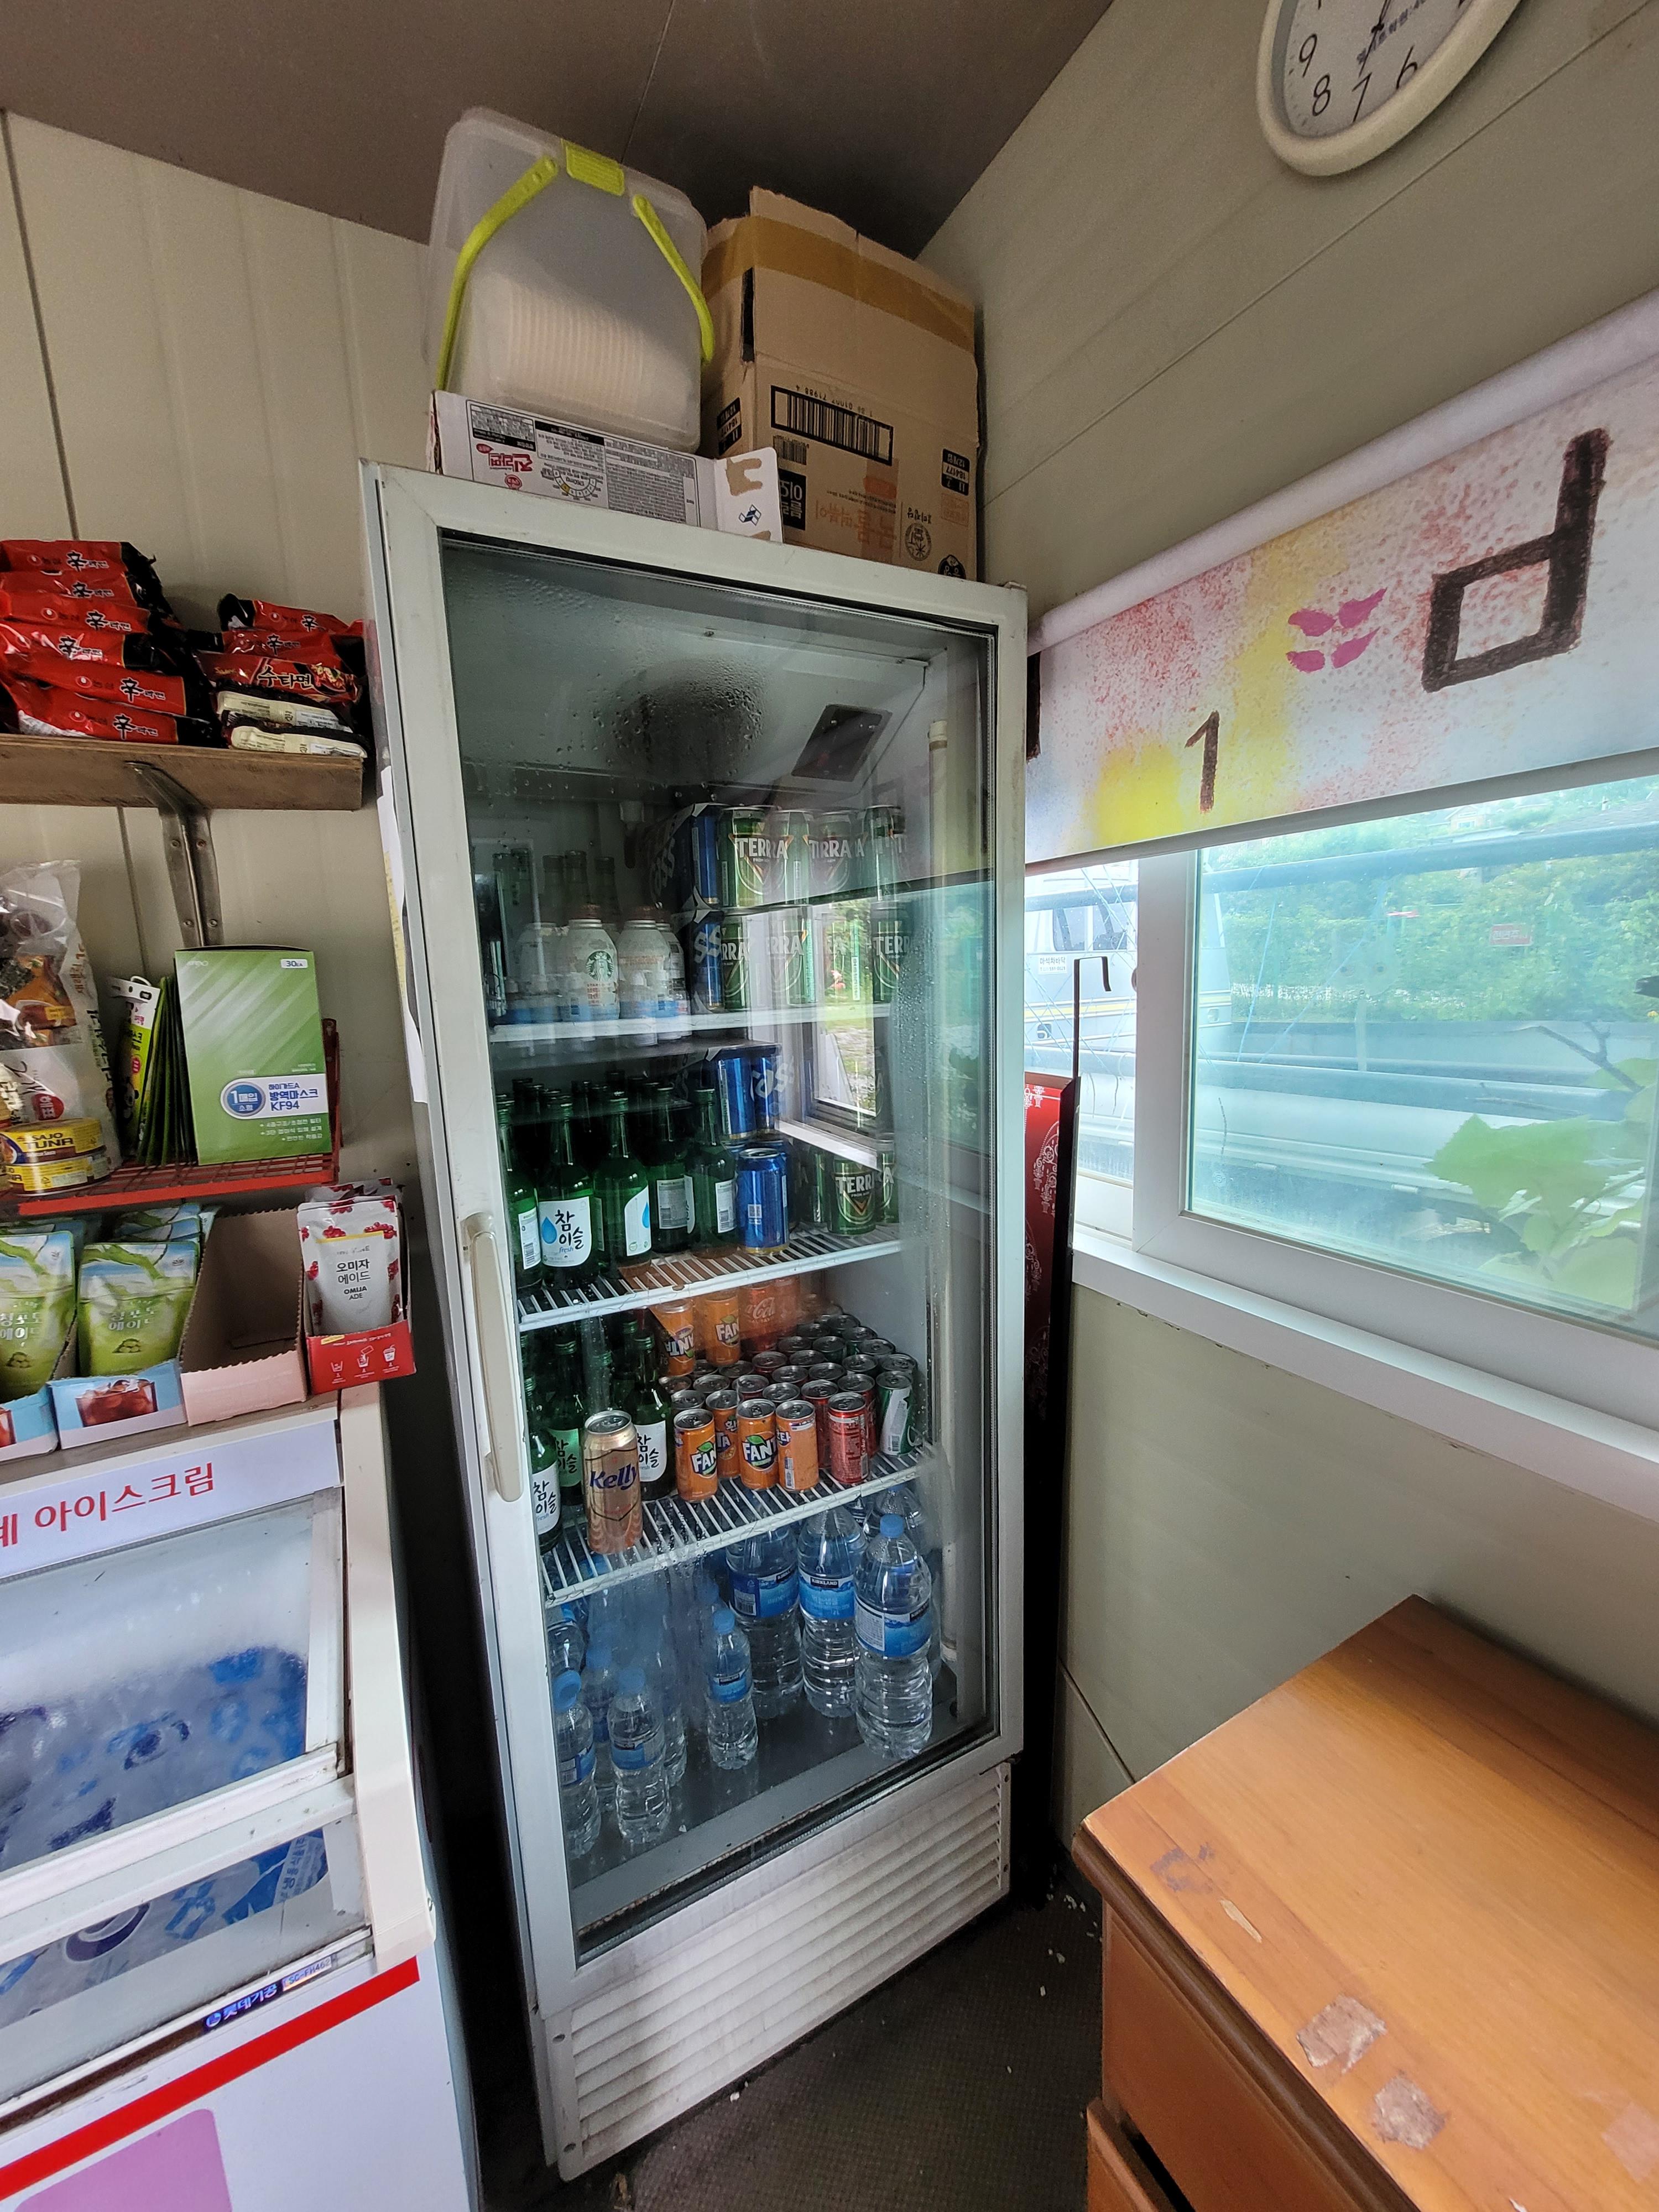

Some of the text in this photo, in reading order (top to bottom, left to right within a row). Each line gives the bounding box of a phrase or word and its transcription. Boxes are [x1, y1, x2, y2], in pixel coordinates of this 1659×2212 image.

[1298, 33, 1318, 77] 9
[1312, 73, 1331, 117] 8
[1352, 71, 1373, 122] 7
[488, 452, 534, 473] 진라면
[257, 665, 315, 689] 수타면
[269, 1088, 320, 1101] 방역마스크
[270, 1100, 300, 1112] KF94
[32, 1132, 64, 1142] SAJO
[554, 1208, 575, 1232] 참
[559, 1225, 585, 1251] 이슬
[559, 1245, 574, 1254] fresh
[336, 1258, 371, 1274] 오미자
[337, 1270, 372, 1285] 에이드
[348, 1292, 363, 1301] ADE
[589, 1463, 638, 1491] Kelly
[34, 1462, 215, 1533] 아이스크림
[534, 1480, 550, 1500] 참
[535, 1491, 557, 1515] 이슬
[223, 1983, 278, 2020] 롯데기공
